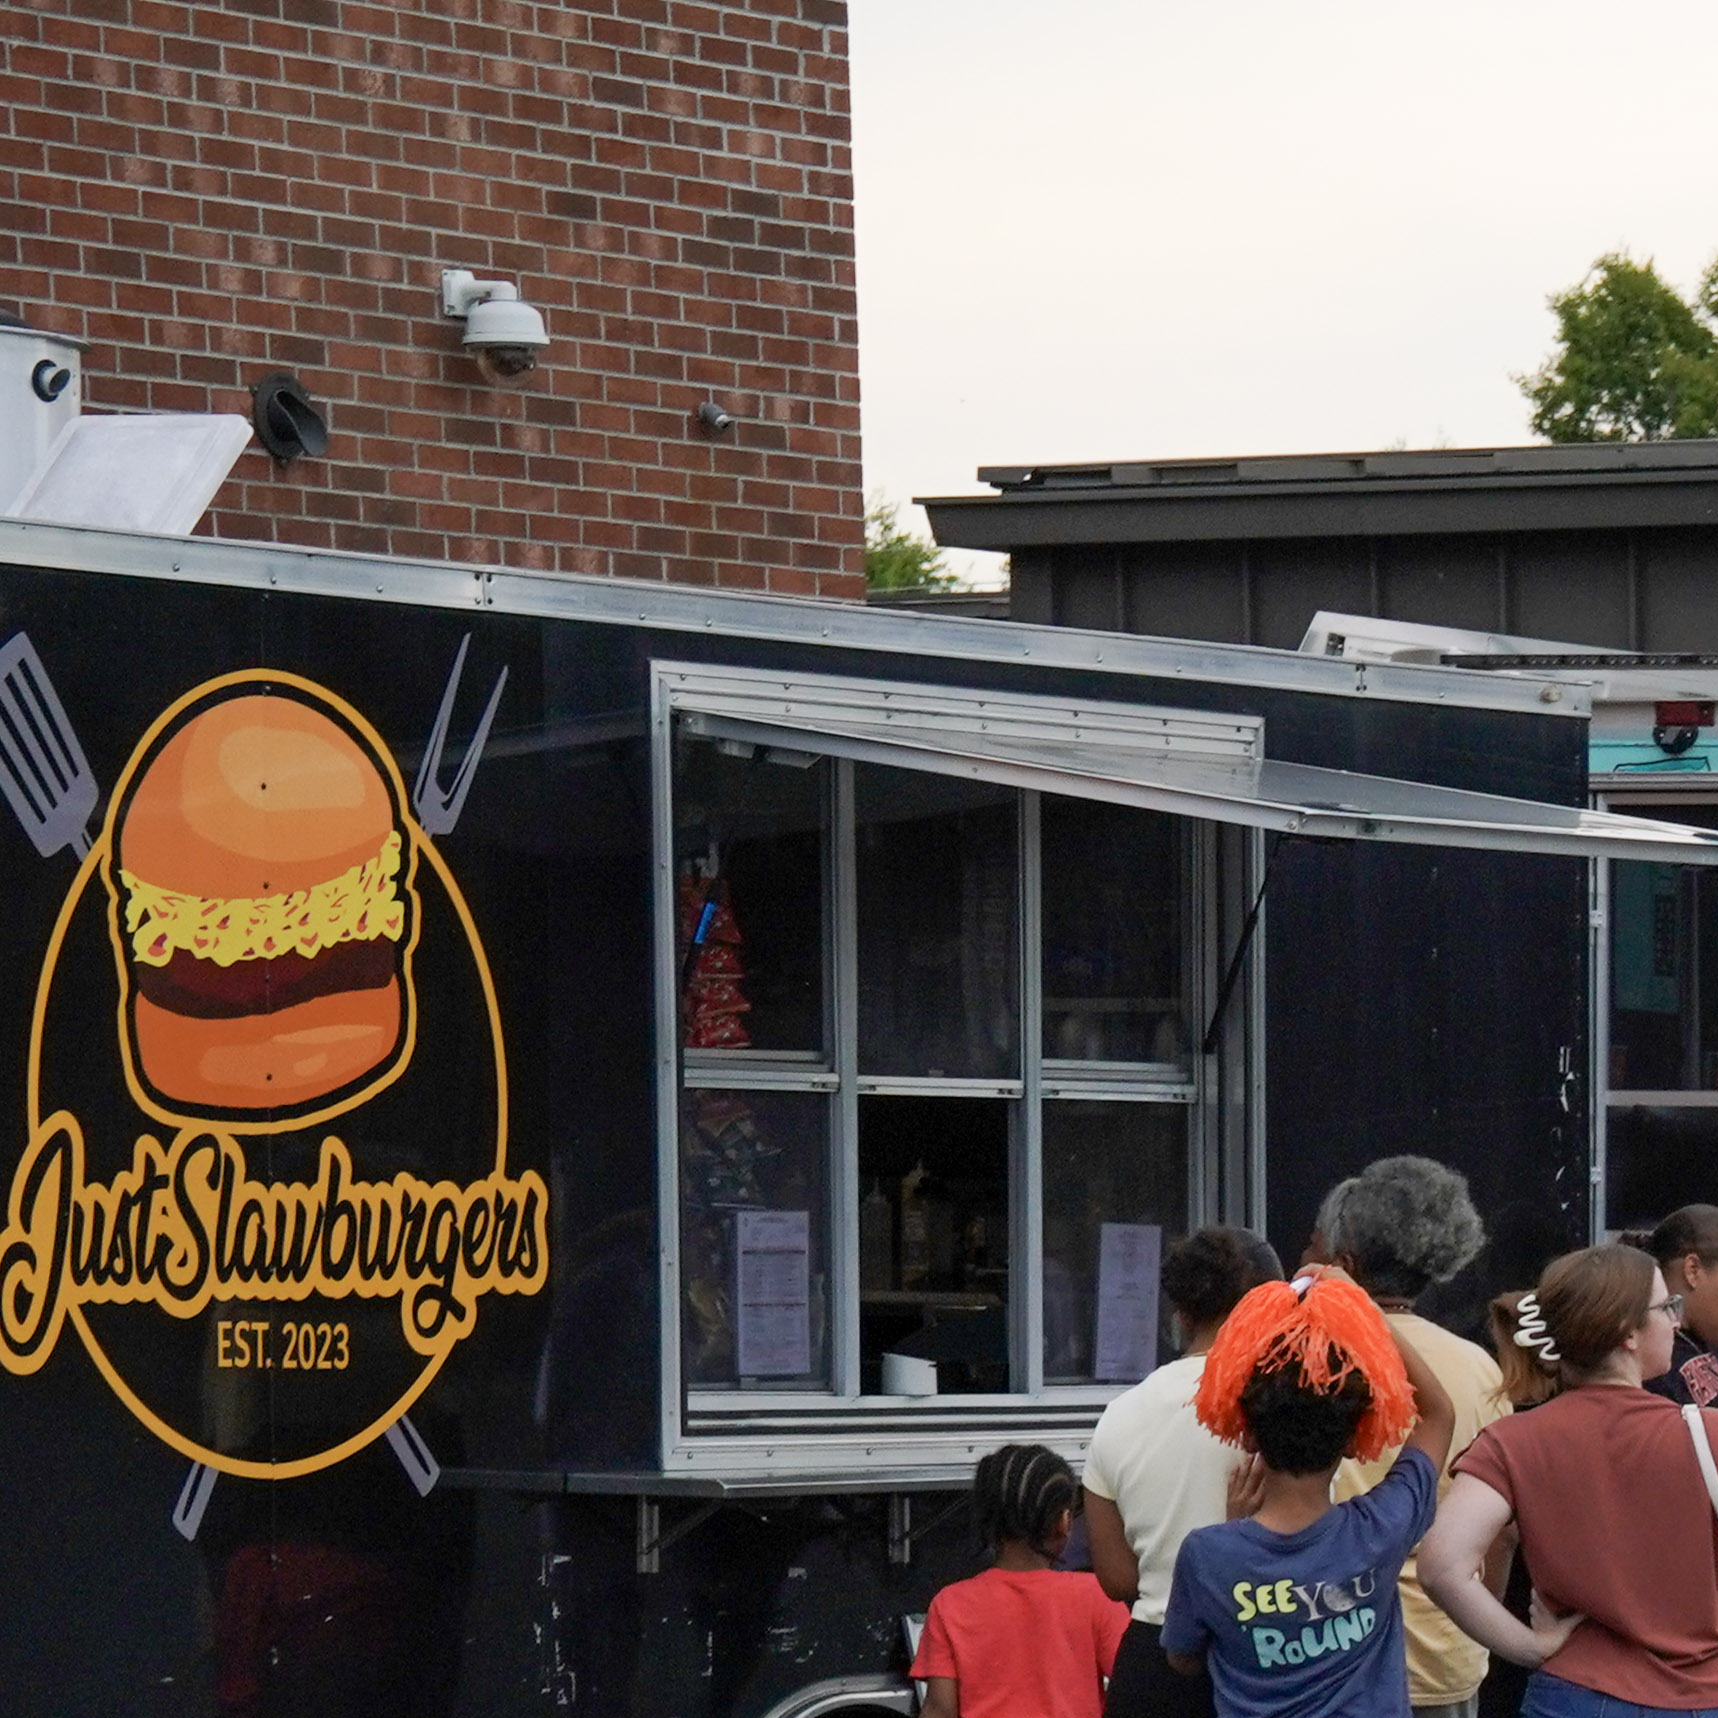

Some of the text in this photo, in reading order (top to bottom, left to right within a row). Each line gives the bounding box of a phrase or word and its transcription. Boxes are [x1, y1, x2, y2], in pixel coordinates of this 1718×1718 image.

[157, 1133, 540, 1338] Slawburgers
[216, 1321, 350, 1370] EST. 2023
[1232, 1568, 1377, 1622] SEE YOU
